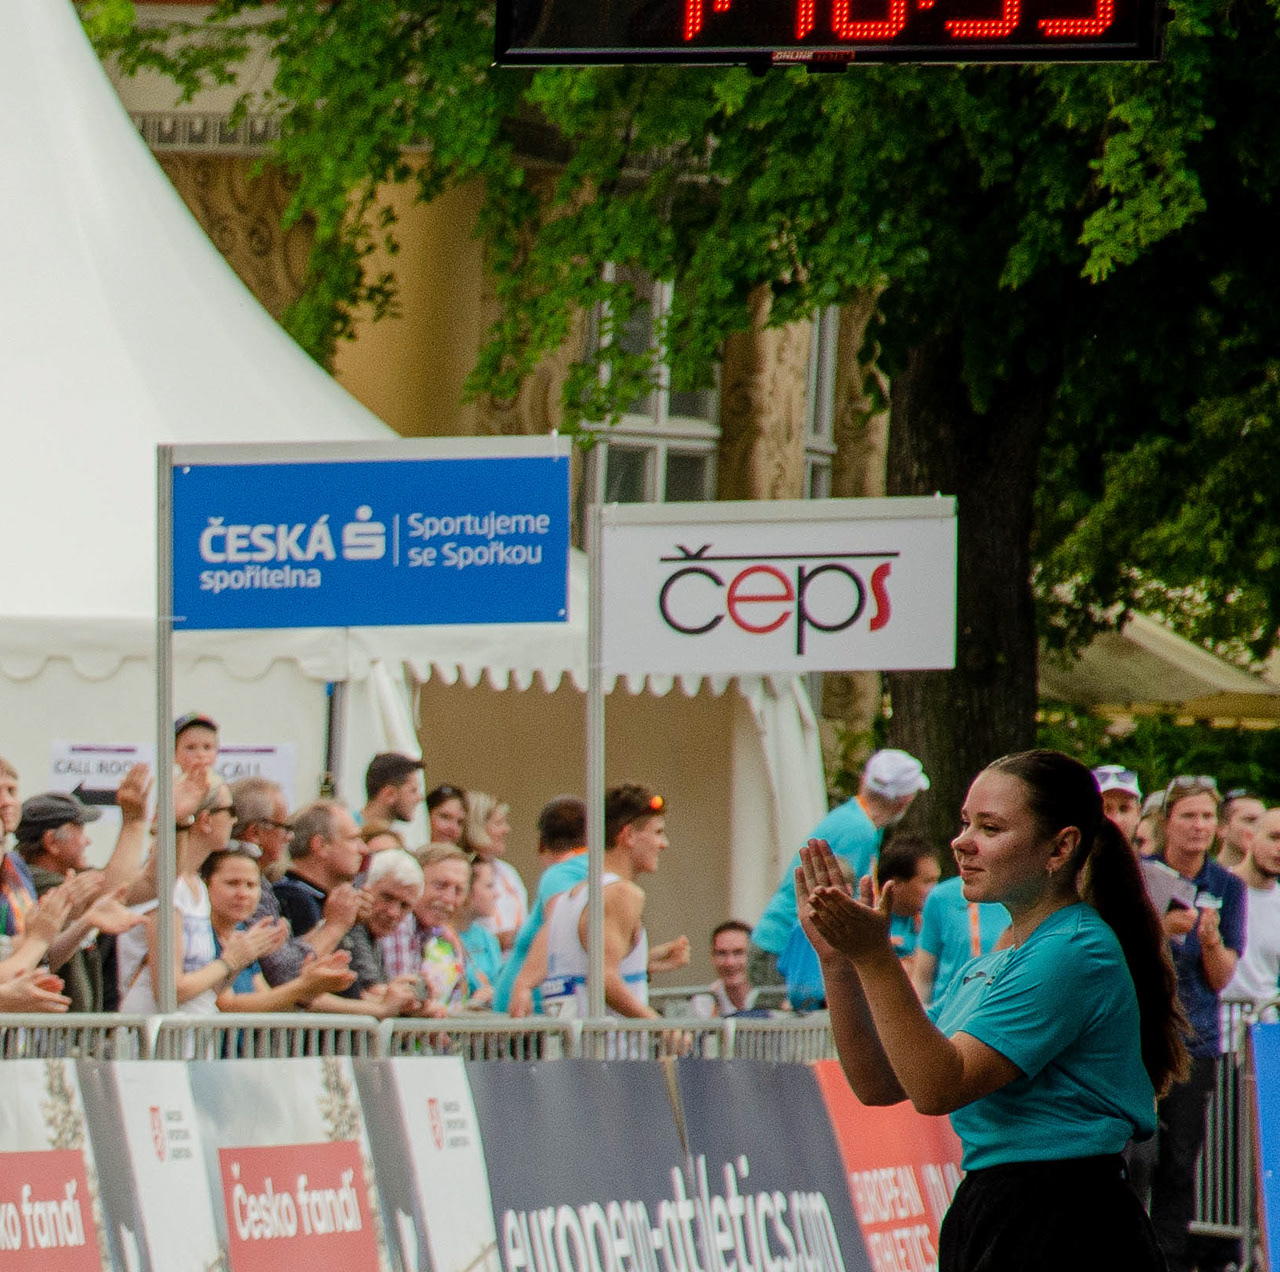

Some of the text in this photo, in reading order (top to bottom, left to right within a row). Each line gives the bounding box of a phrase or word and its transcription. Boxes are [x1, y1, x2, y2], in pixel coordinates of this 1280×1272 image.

[198, 513, 337, 564] ČESKÁ
[407, 510, 551, 541] Sportujeme
[407, 540, 544, 571] se Spořkou
[198, 564, 322, 594] spořitelna
[231, 1161, 298, 1241] Česko
